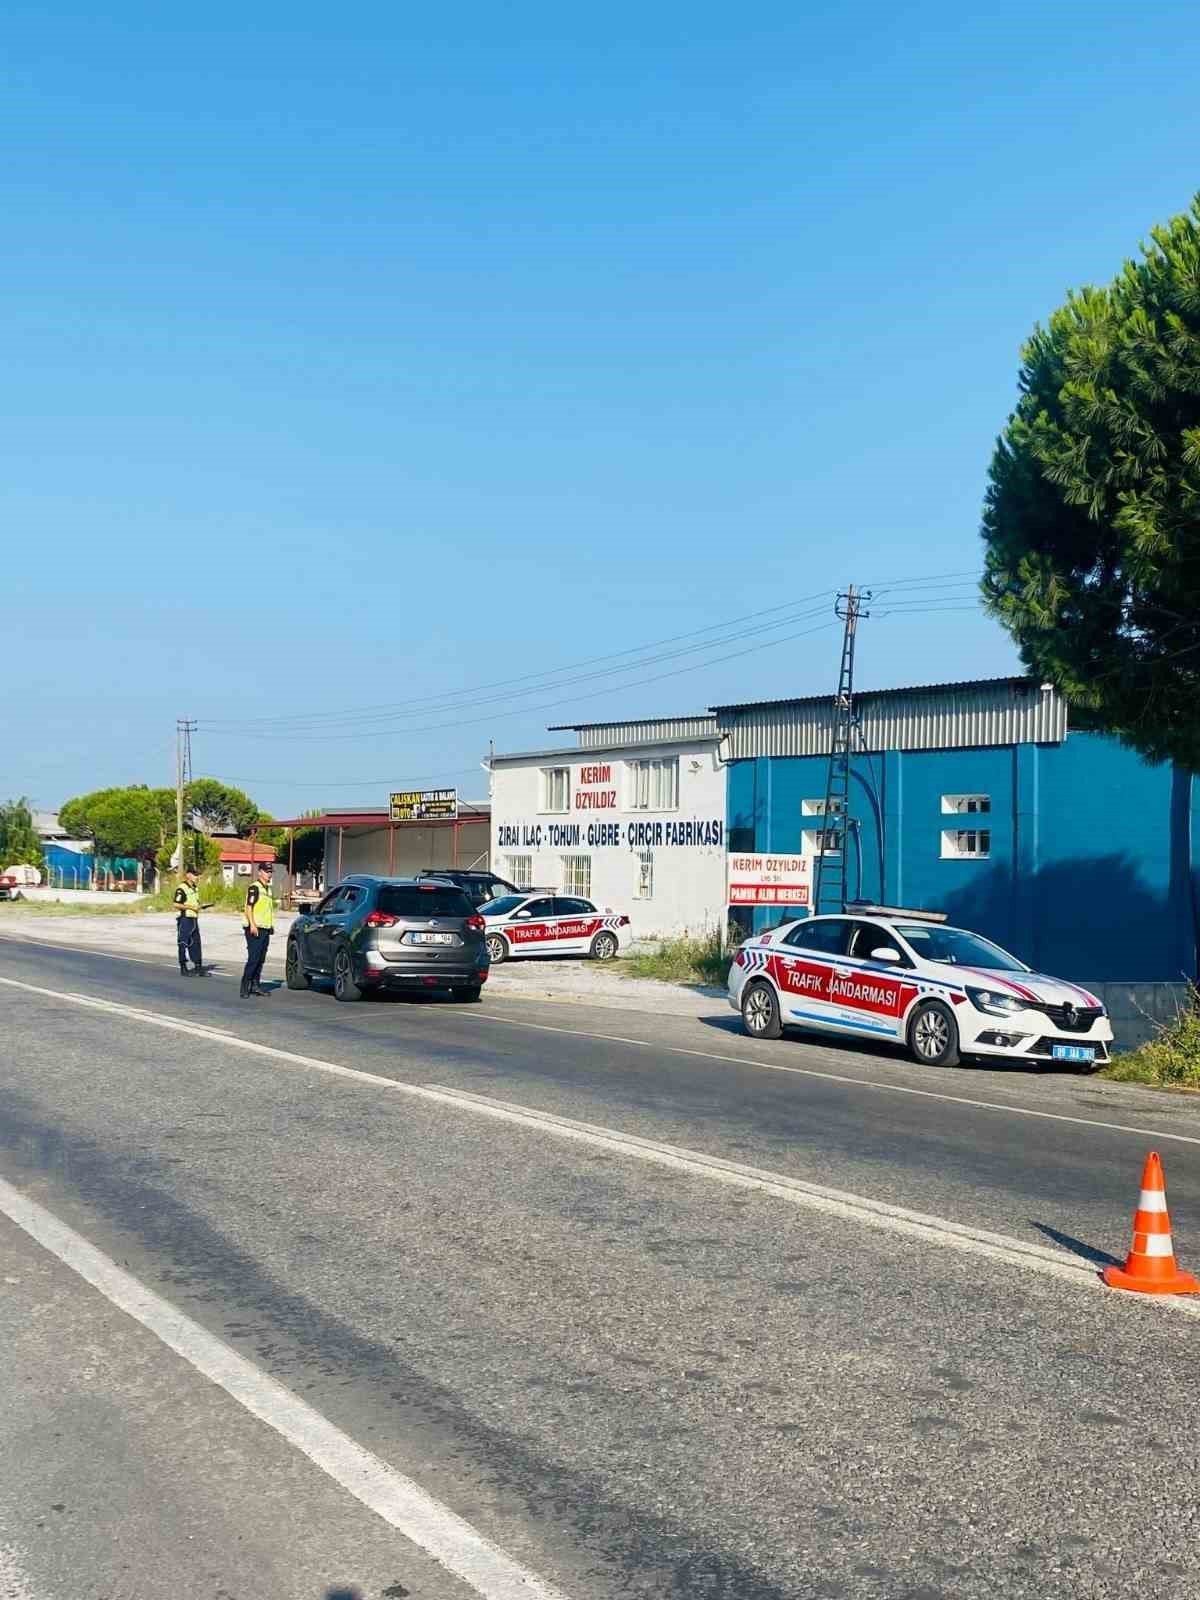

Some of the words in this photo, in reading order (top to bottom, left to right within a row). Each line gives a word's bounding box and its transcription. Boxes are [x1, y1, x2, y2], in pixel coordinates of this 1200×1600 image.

[549, 824, 580, 846] TOHUM
[587, 818, 620, 848] GÜBRE
[665, 815, 723, 847] FABRİKASI
[544, 923, 589, 938] JANDARMASI
[826, 979, 897, 1008] JANDARMASI
